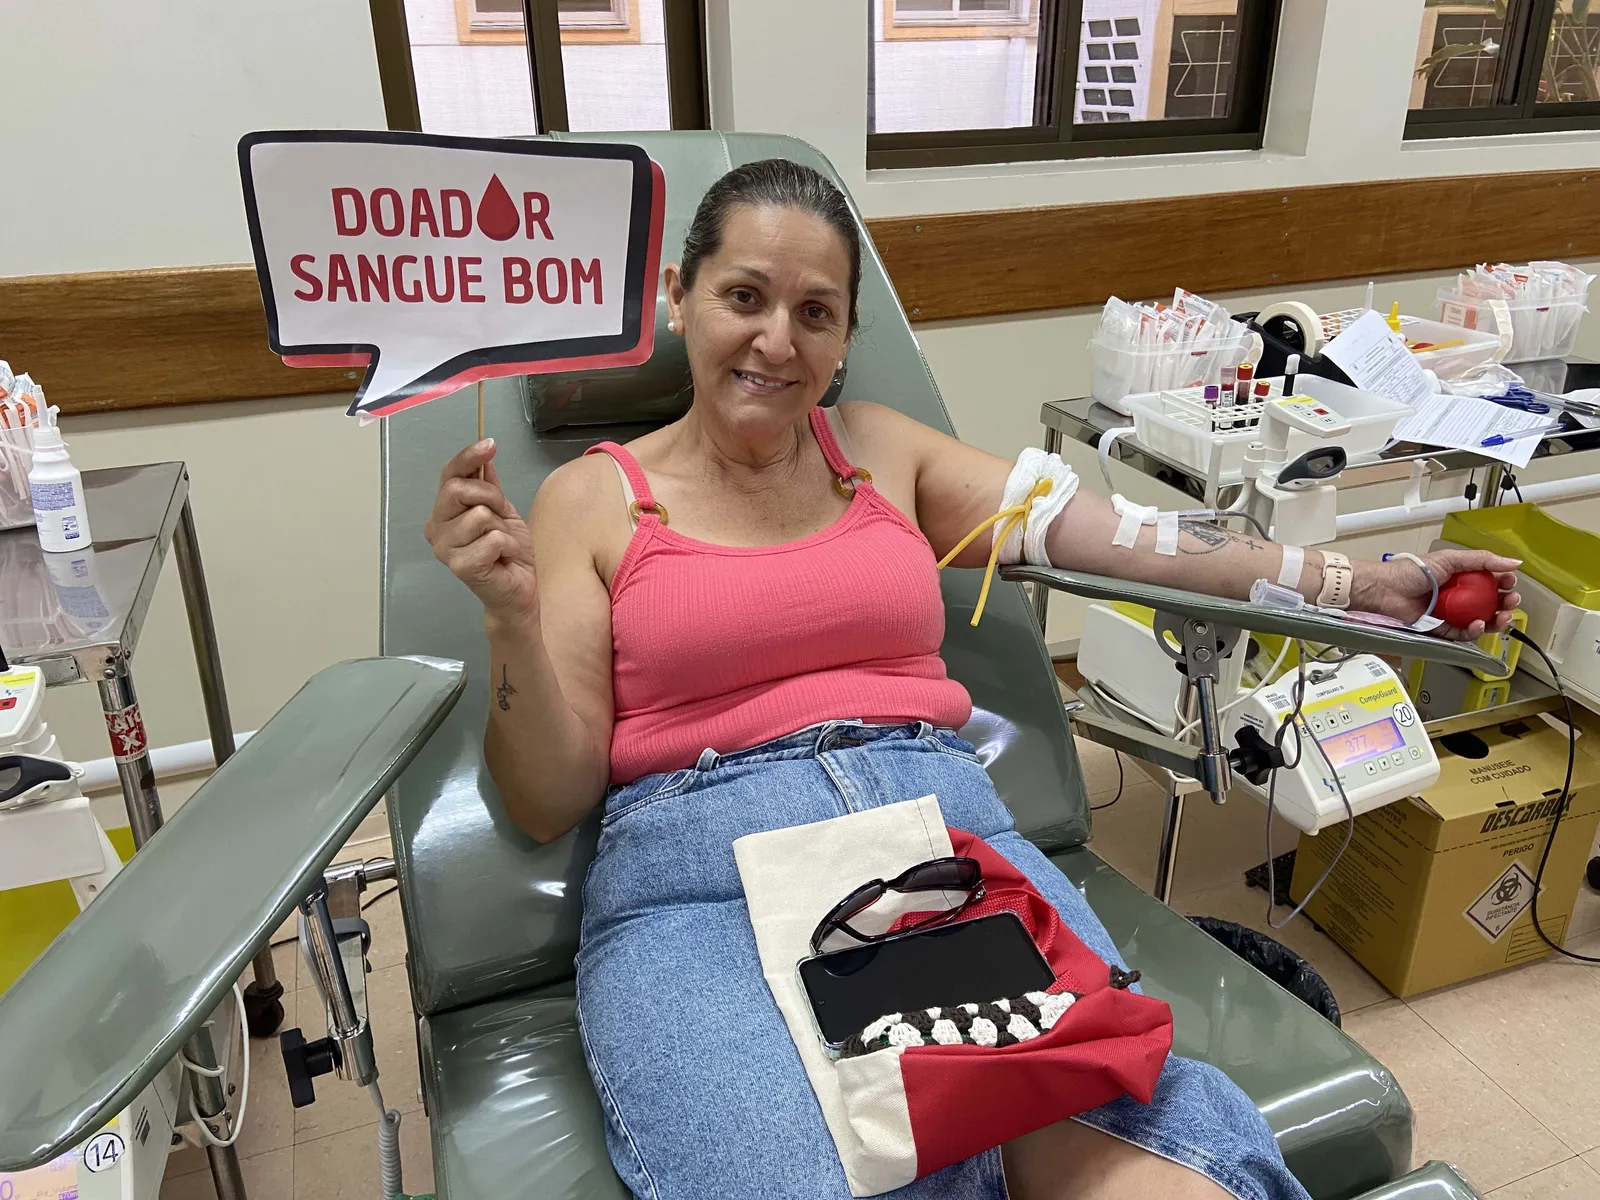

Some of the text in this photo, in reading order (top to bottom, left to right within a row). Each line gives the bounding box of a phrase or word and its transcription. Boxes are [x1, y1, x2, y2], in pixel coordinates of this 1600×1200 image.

[331, 173, 554, 241] DOADOR
[290, 253, 603, 305] SANGUE BOM
[1359, 686, 1398, 704] CompoGuard
[1395, 706, 1412, 722] 20
[1469, 759, 1516, 775] MANUSEIE
[1470, 764, 1532, 785] COM CUIDADO
[1502, 843, 1535, 858] PERIGO
[90, 1139, 119, 1167] 14
